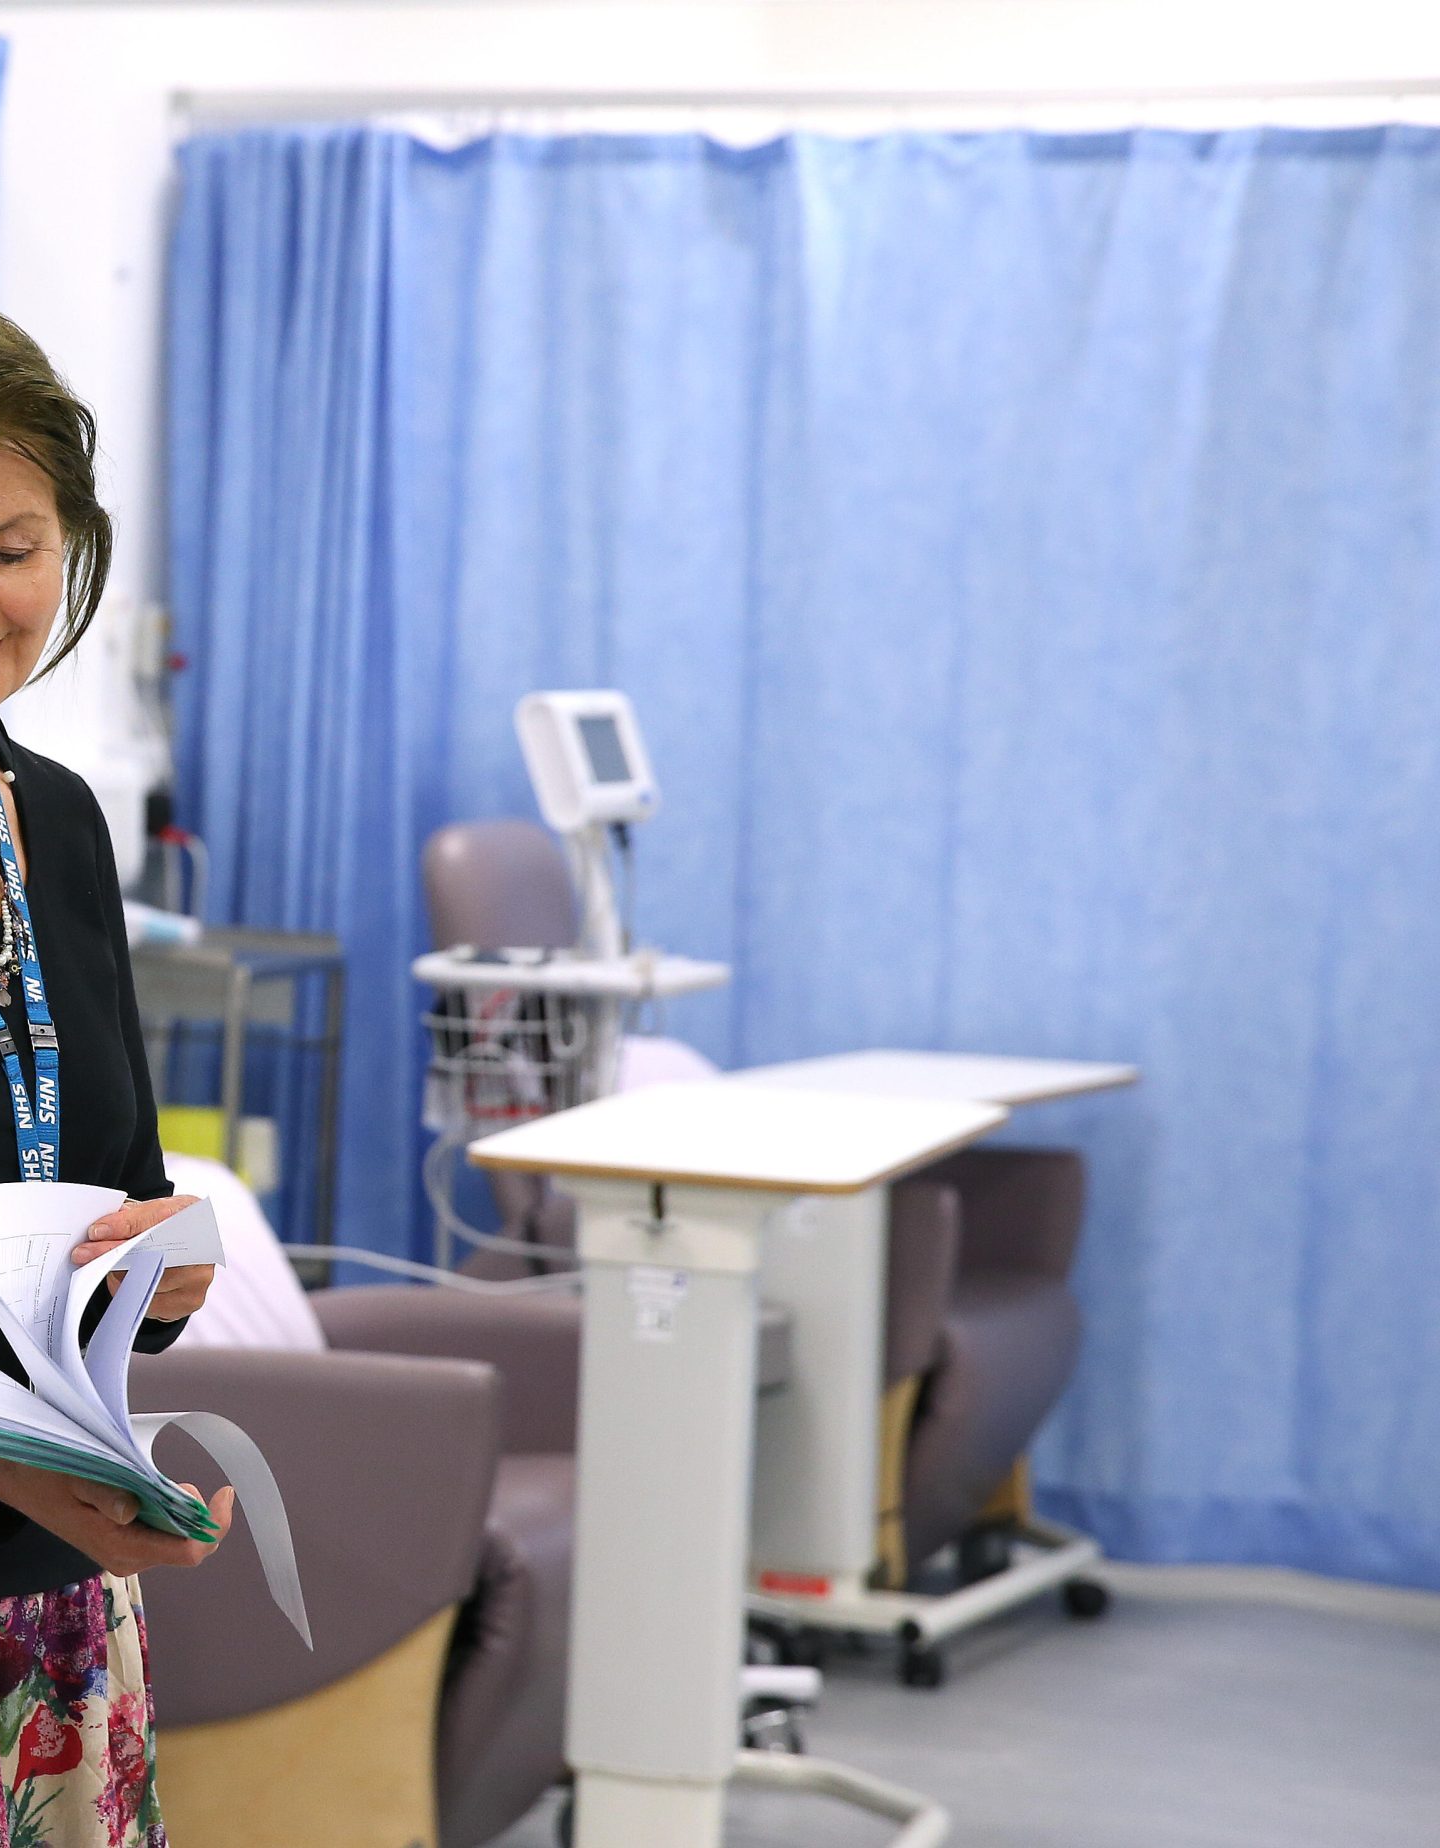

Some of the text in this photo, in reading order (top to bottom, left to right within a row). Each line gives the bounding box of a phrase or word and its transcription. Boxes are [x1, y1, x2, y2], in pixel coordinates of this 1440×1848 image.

[3, 858, 25, 903] NHS
[12, 1083, 33, 1129] NHS
[38, 1076, 56, 1125] NHS
[38, 1142, 55, 1182] NH
